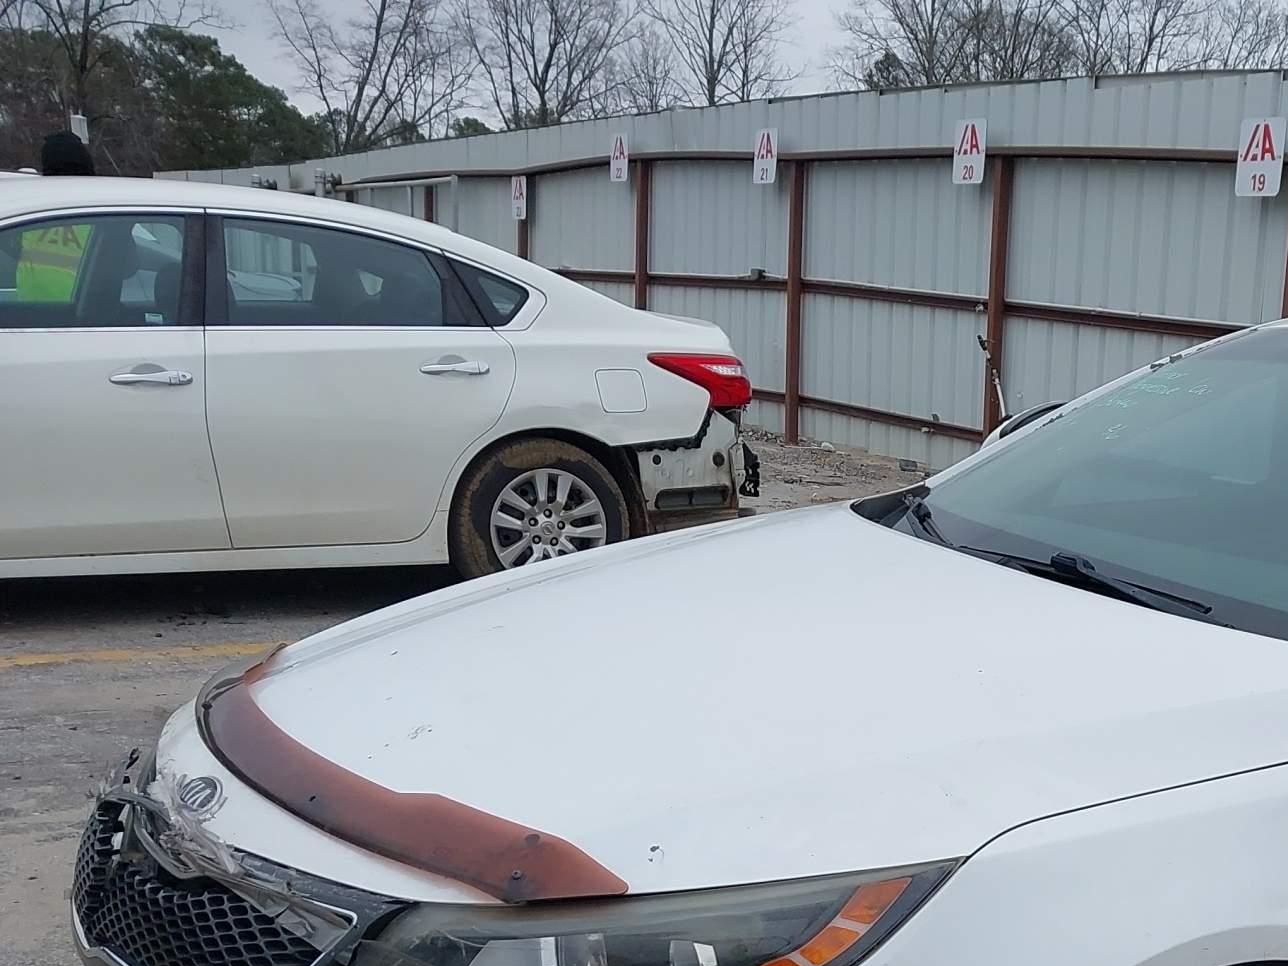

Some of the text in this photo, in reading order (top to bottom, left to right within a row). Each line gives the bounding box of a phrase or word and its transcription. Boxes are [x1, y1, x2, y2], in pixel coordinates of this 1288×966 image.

[615, 167, 623, 179] 22
[760, 167, 768, 181] 21
[962, 164, 974, 180] 20
[1251, 173, 1266, 192] 19
